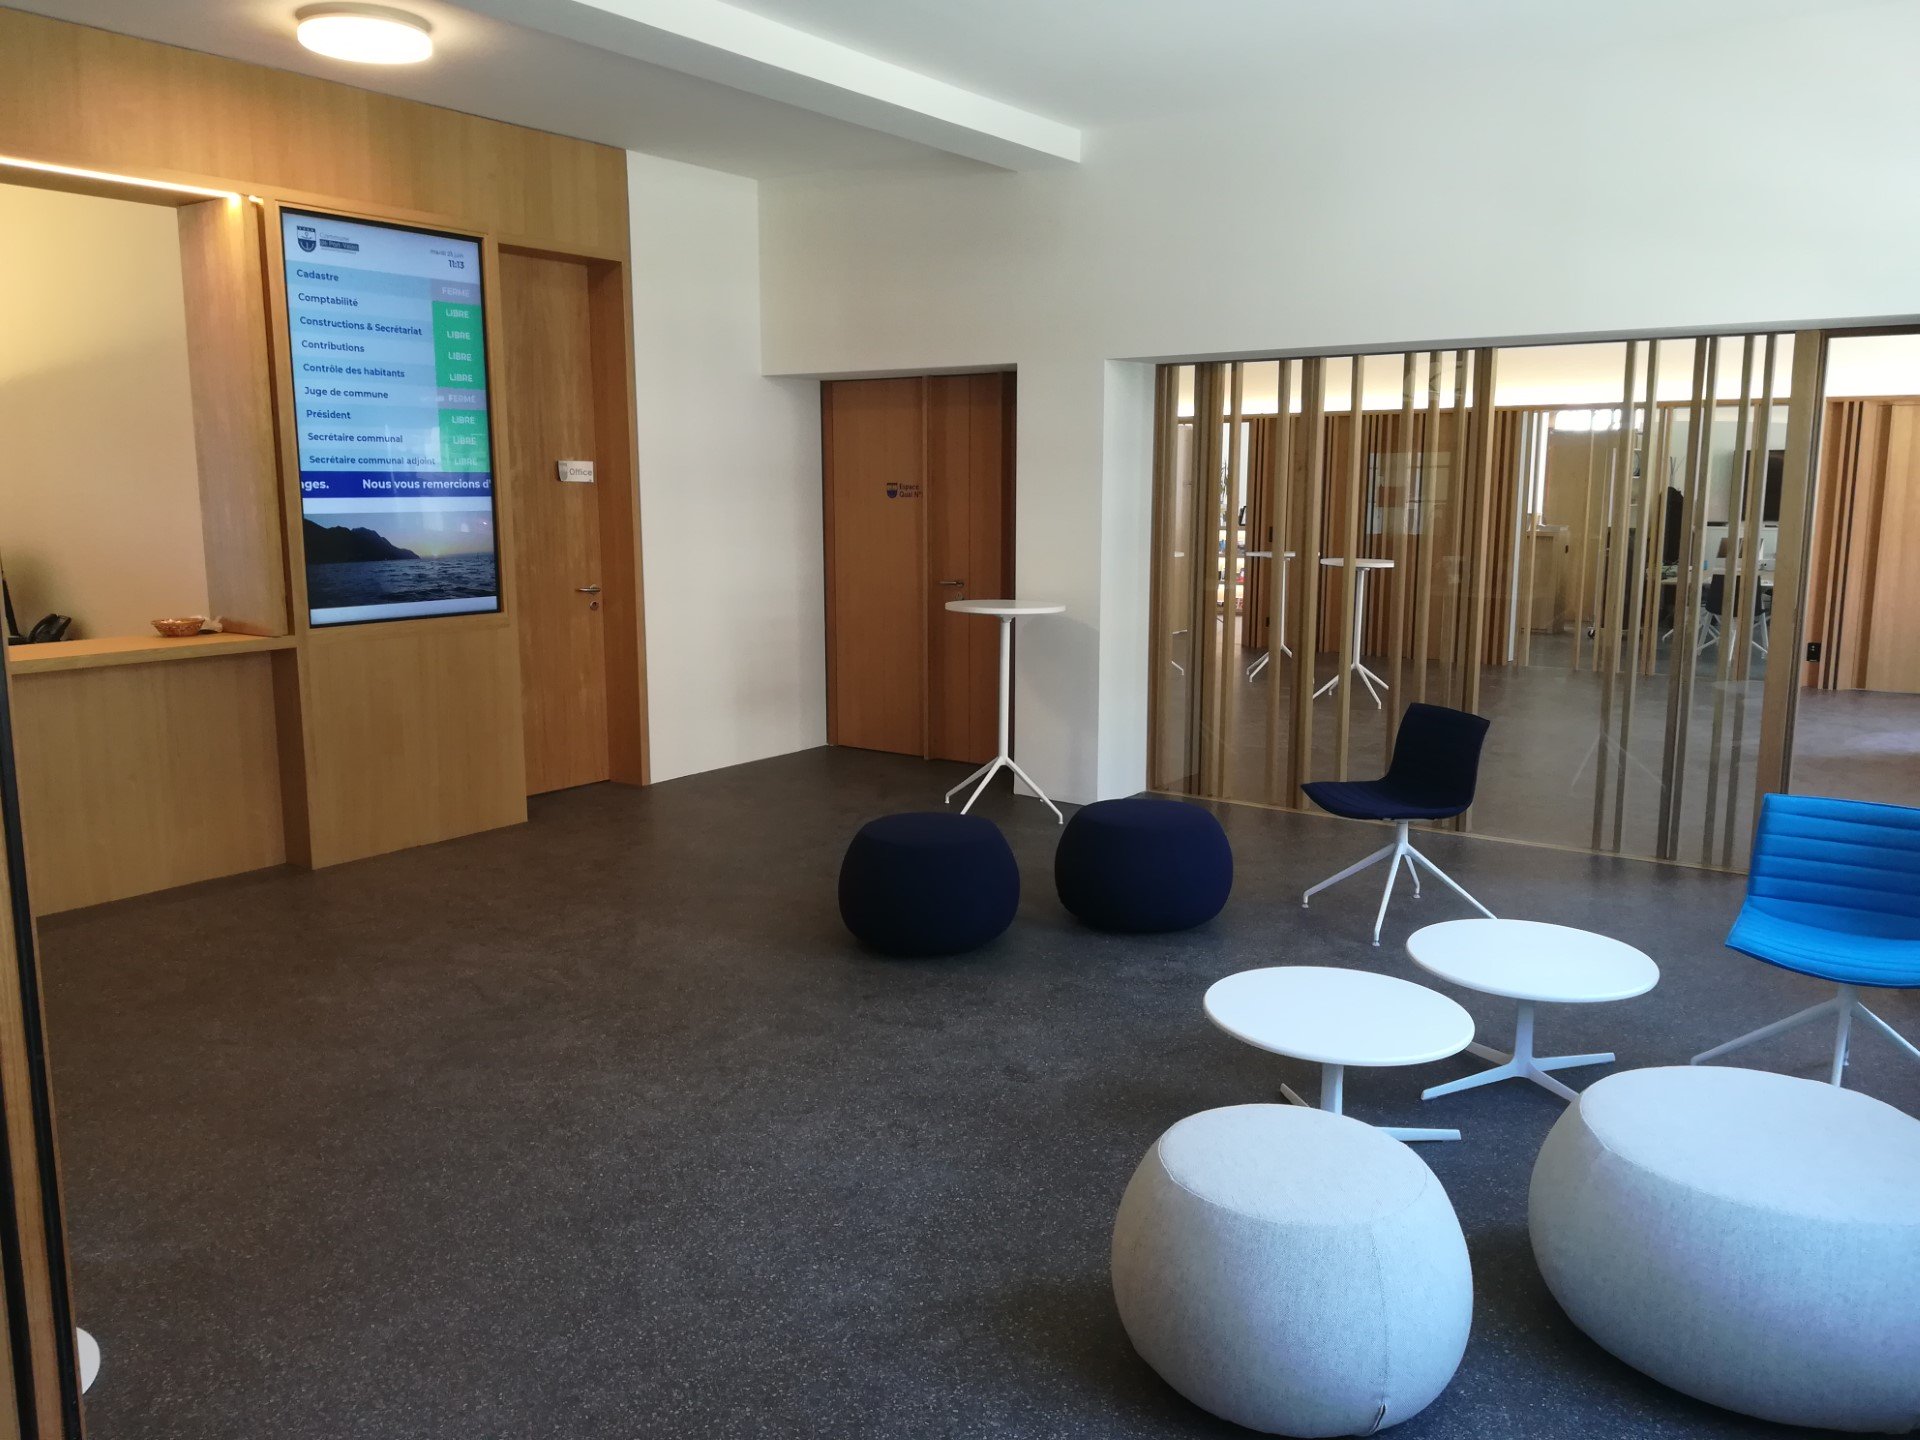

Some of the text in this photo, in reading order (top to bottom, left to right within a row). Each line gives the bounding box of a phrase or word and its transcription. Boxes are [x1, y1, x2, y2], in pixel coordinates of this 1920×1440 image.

[448, 259, 465, 269] 11:13
[296, 269, 339, 282] Cadastre
[298, 293, 358, 307] Comptabilité
[446, 309, 469, 319] LIBRE
[300, 316, 423, 336] Constructions & Secrétariat
[446, 331, 471, 341] LIBRE
[301, 340, 365, 353] Contributions
[448, 351, 472, 362] LIBRE
[303, 363, 405, 378] Contrôle des habitants
[449, 373, 473, 383] LIBRE
[304, 387, 389, 399] Juge de commune
[306, 409, 351, 420] Président
[452, 415, 475, 424] LIBRE
[307, 432, 403, 443] Secrétaire communal
[453, 436, 477, 445] LIBRE
[309, 455, 436, 467] Secrétaire communal adjoint
[454, 457, 478, 466] LIBRE
[569, 468, 592, 476] Office
[362, 479, 391, 489] Nous
[394, 481, 420, 489] vous
[422, 479, 480, 489] remercions
